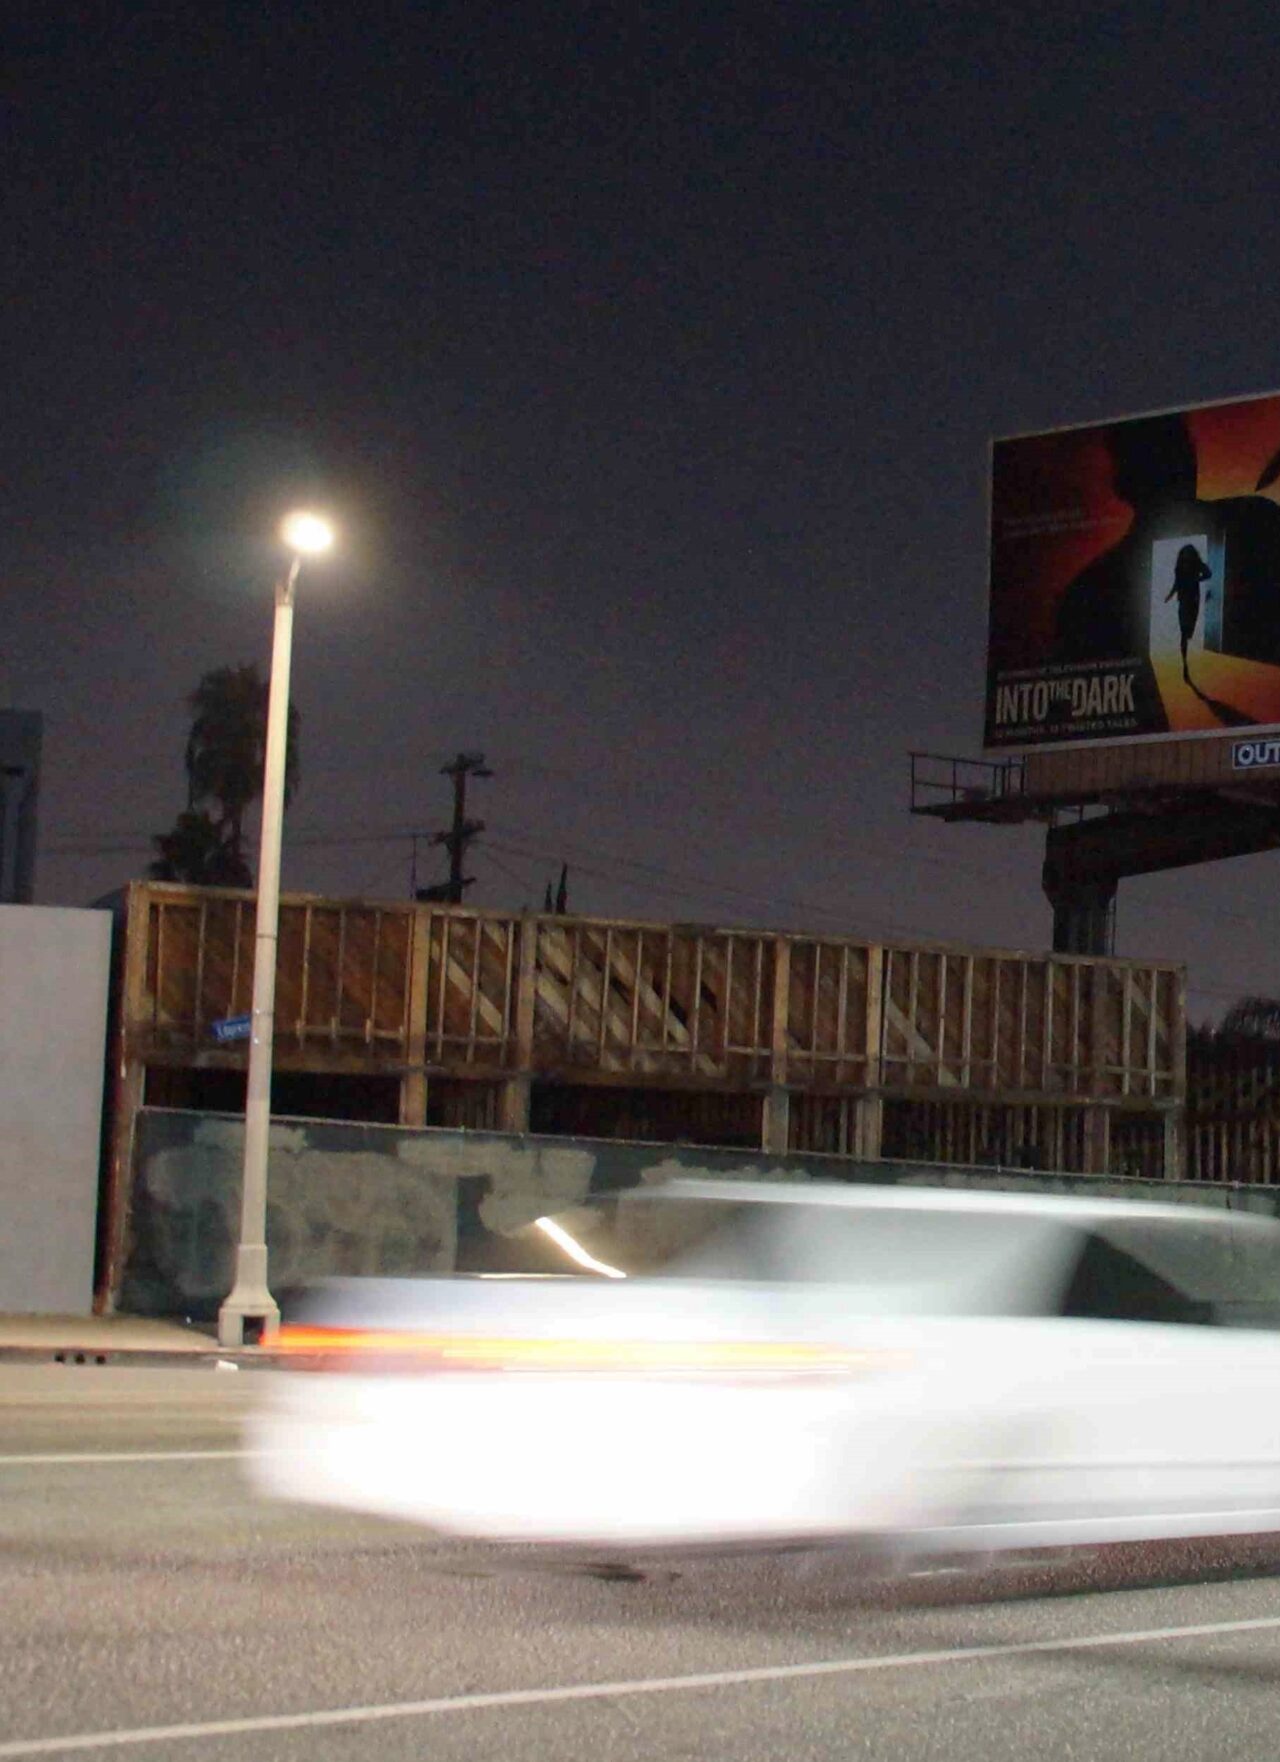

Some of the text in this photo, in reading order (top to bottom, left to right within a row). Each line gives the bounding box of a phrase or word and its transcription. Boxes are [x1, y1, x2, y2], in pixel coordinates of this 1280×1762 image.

[995, 674, 1136, 724] INTO THE DARK
